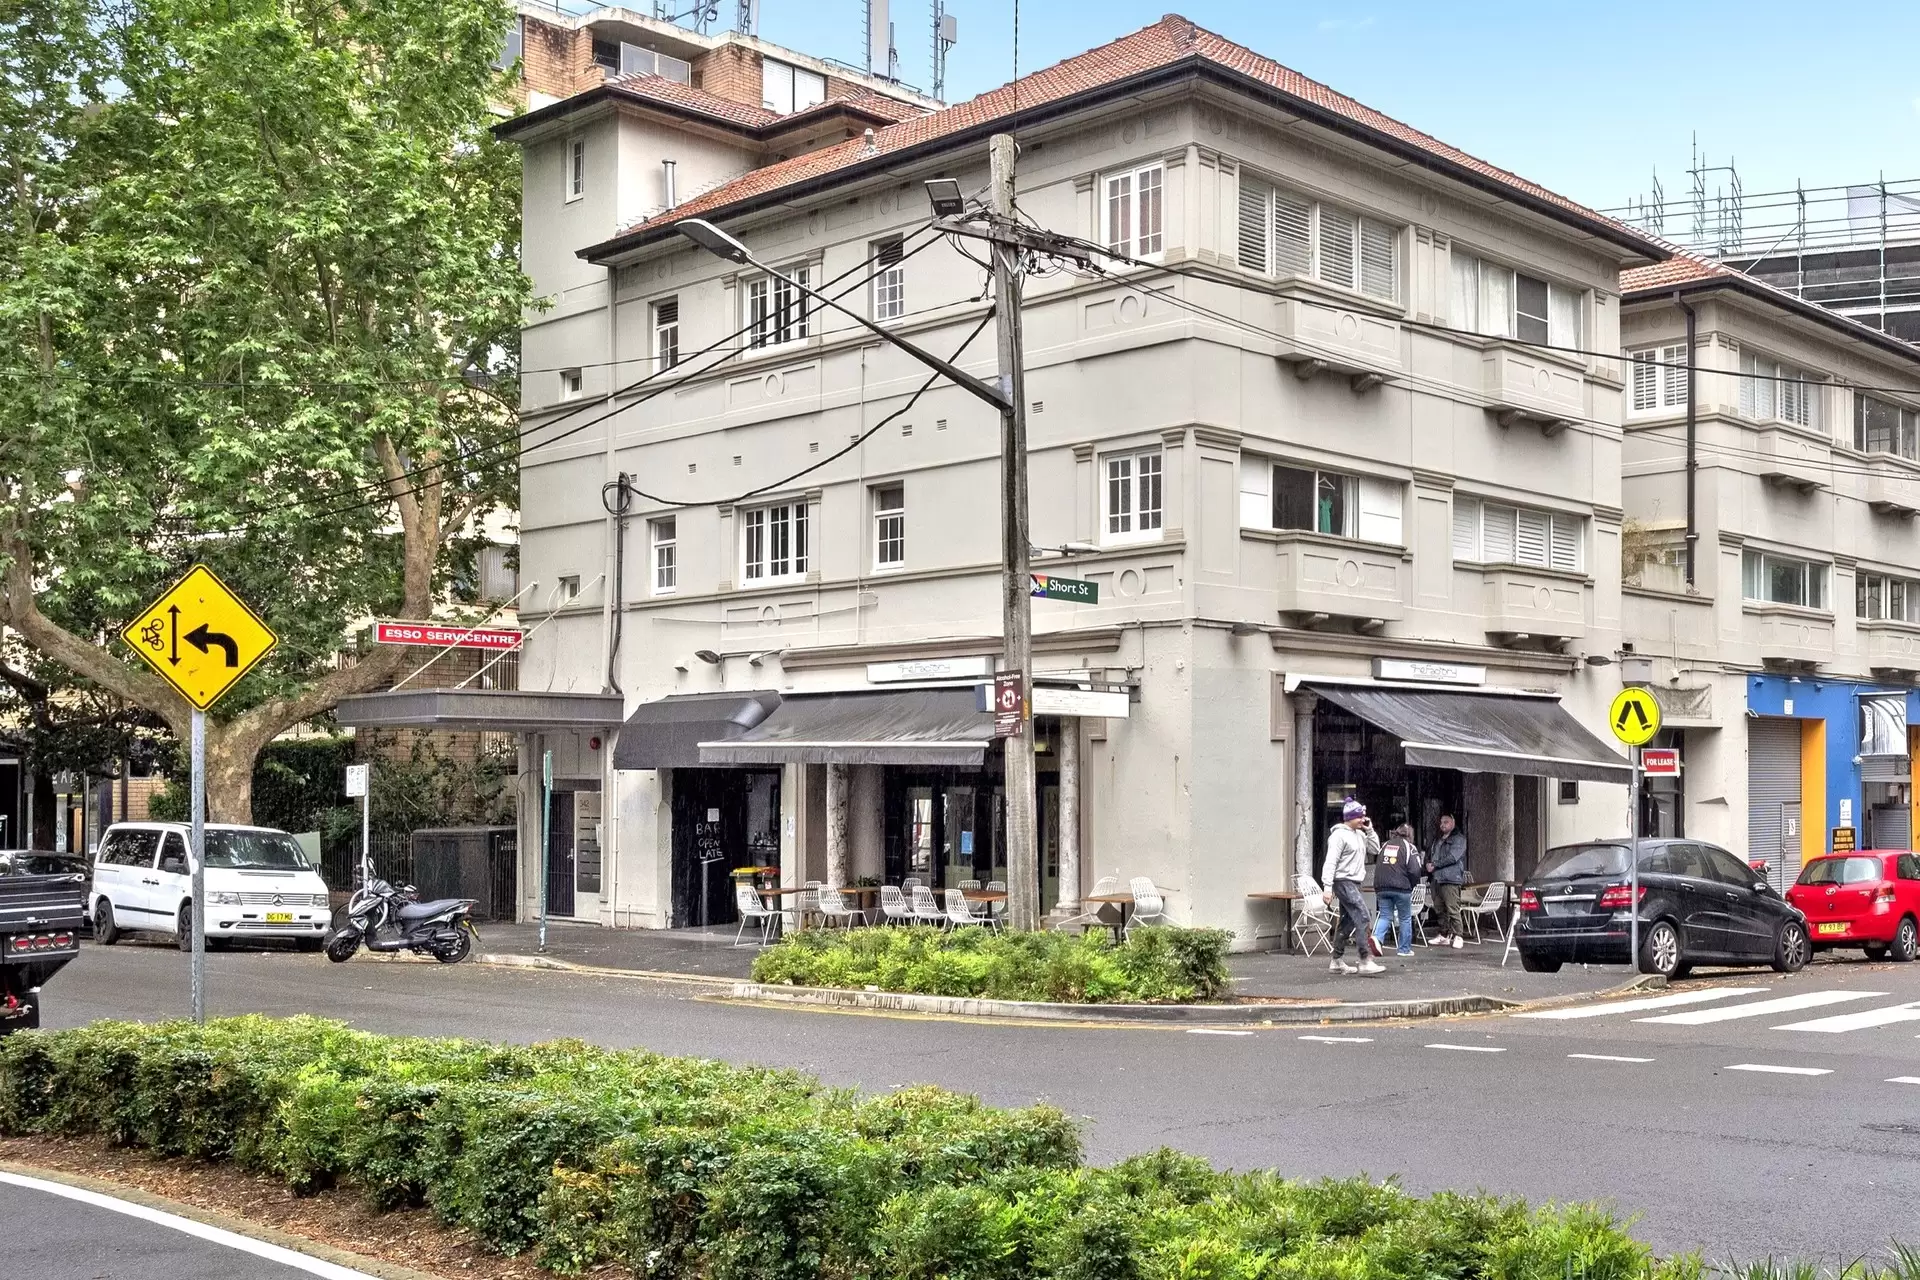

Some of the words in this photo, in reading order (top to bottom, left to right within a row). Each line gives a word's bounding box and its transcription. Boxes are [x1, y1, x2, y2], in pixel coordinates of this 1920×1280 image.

[1049, 579, 1077, 594] Short
[1078, 583, 1089, 595] St
[385, 628, 422, 639] ESSO
[426, 630, 516, 644] SERVICENTRE
[996, 673, 1021, 682] Alcohol-Free
[1646, 758, 1657, 766] FOR
[1657, 758, 1674, 766] LEASE
[696, 822, 721, 835] BAR
[698, 838, 720, 849] OPEN
[699, 848, 723, 858] LATE
